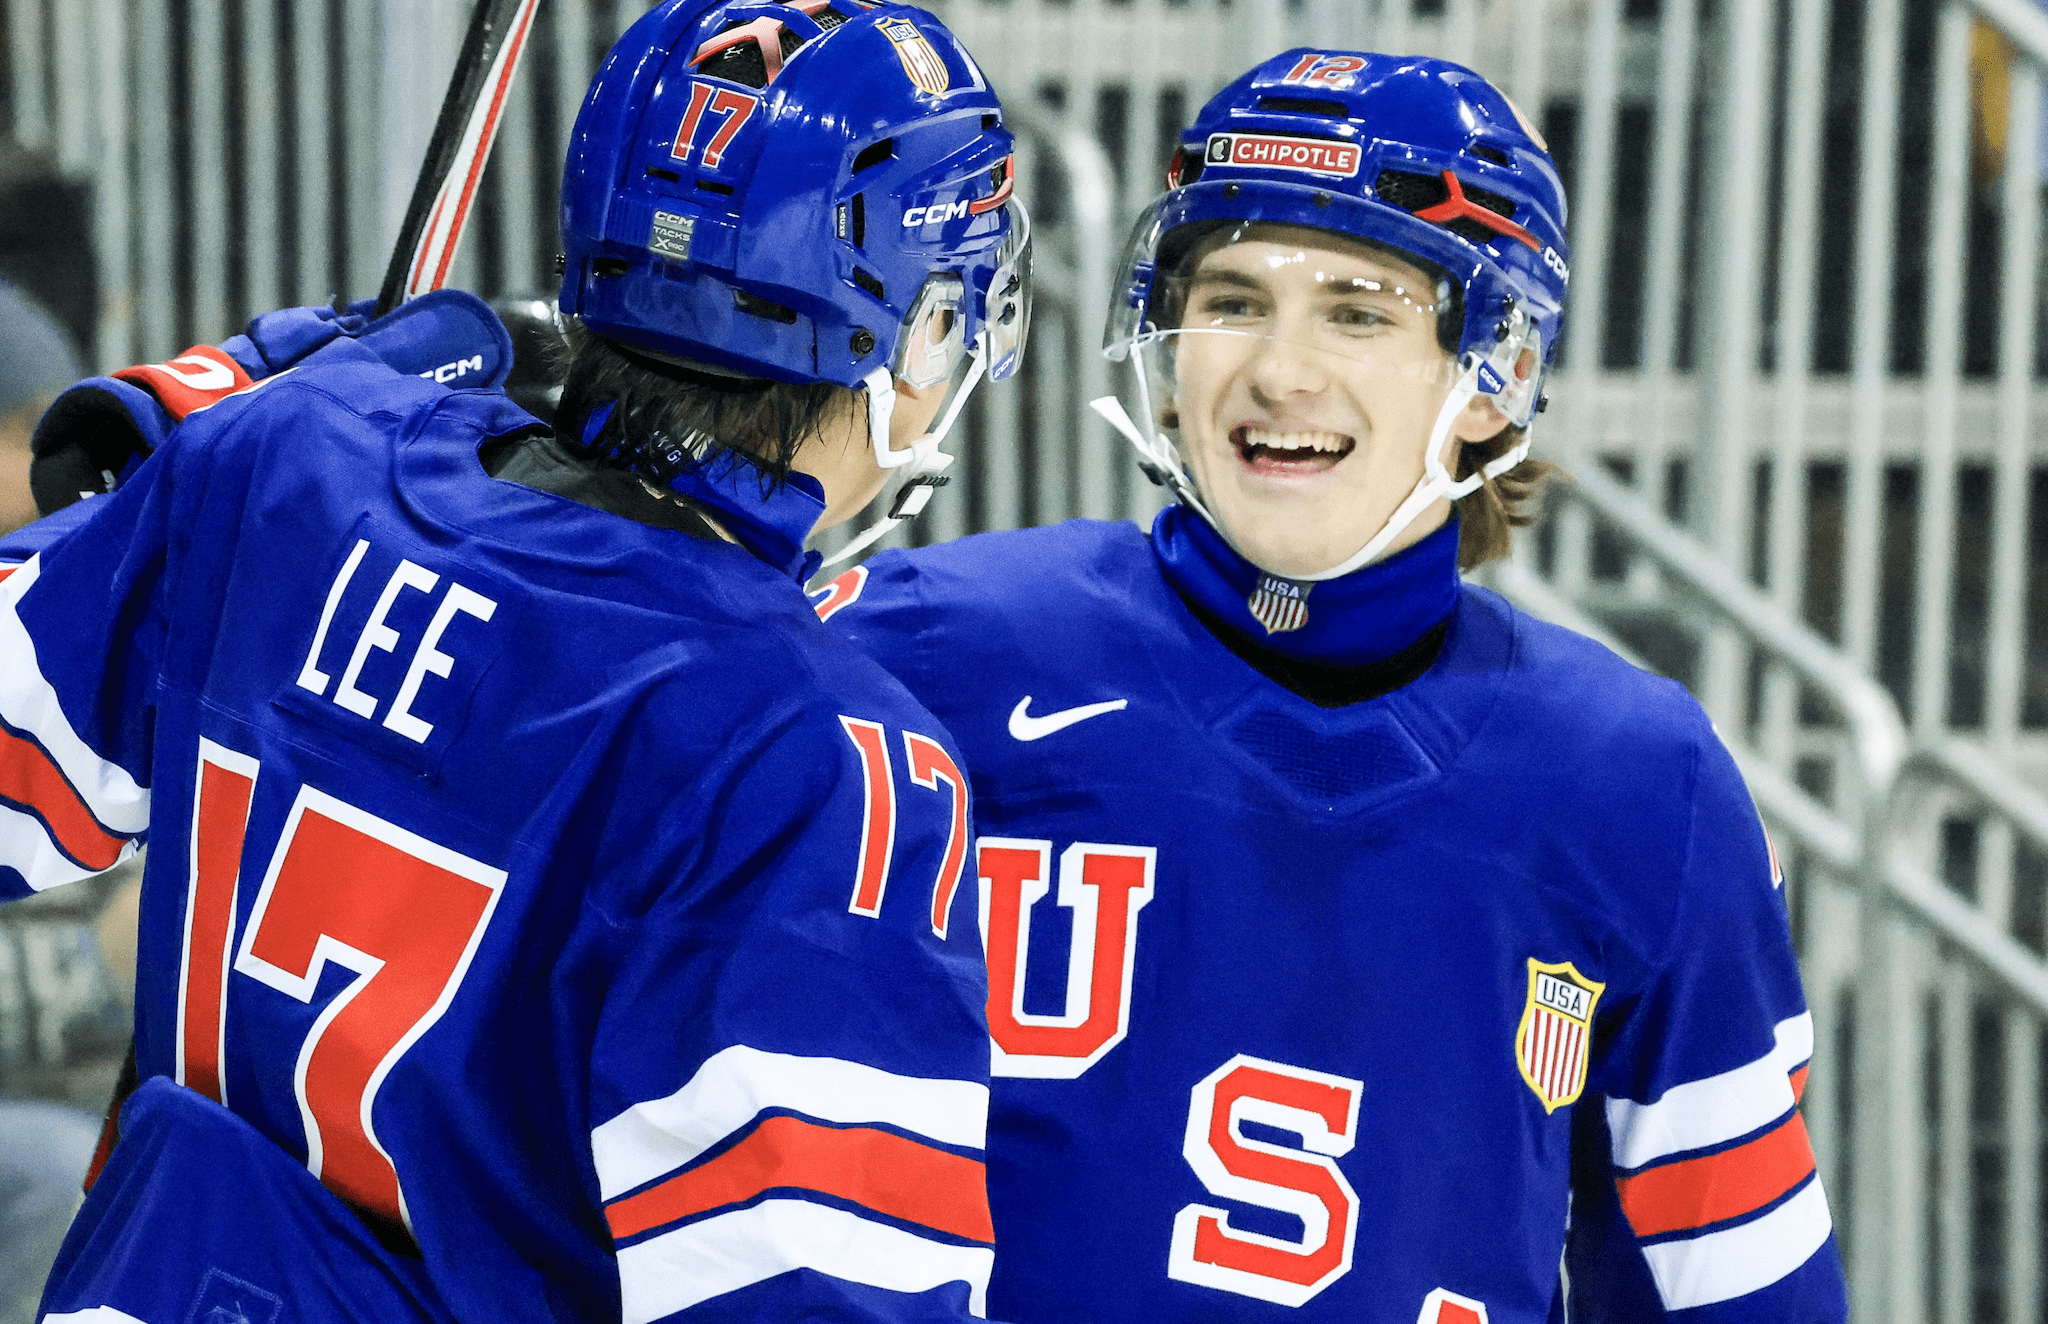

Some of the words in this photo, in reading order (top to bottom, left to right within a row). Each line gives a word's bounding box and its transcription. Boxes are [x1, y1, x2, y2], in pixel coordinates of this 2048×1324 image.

[889, 26, 914, 39] USA
[1281, 54, 1368, 90] 12
[671, 81, 758, 168] 17
[1237, 142, 1352, 169] CHIPOTLE
[654, 210, 695, 227] CCM
[902, 199, 969, 228] CCM
[652, 225, 691, 242] TACKS
[1543, 246, 1570, 285] CCM
[1480, 367, 1502, 393] CCM
[1264, 577, 1299, 599] USA
[296, 538, 498, 744] LEE
[839, 715, 969, 939] 17
[176, 735, 509, 1259] 17
[1543, 978, 1582, 1015] USA
